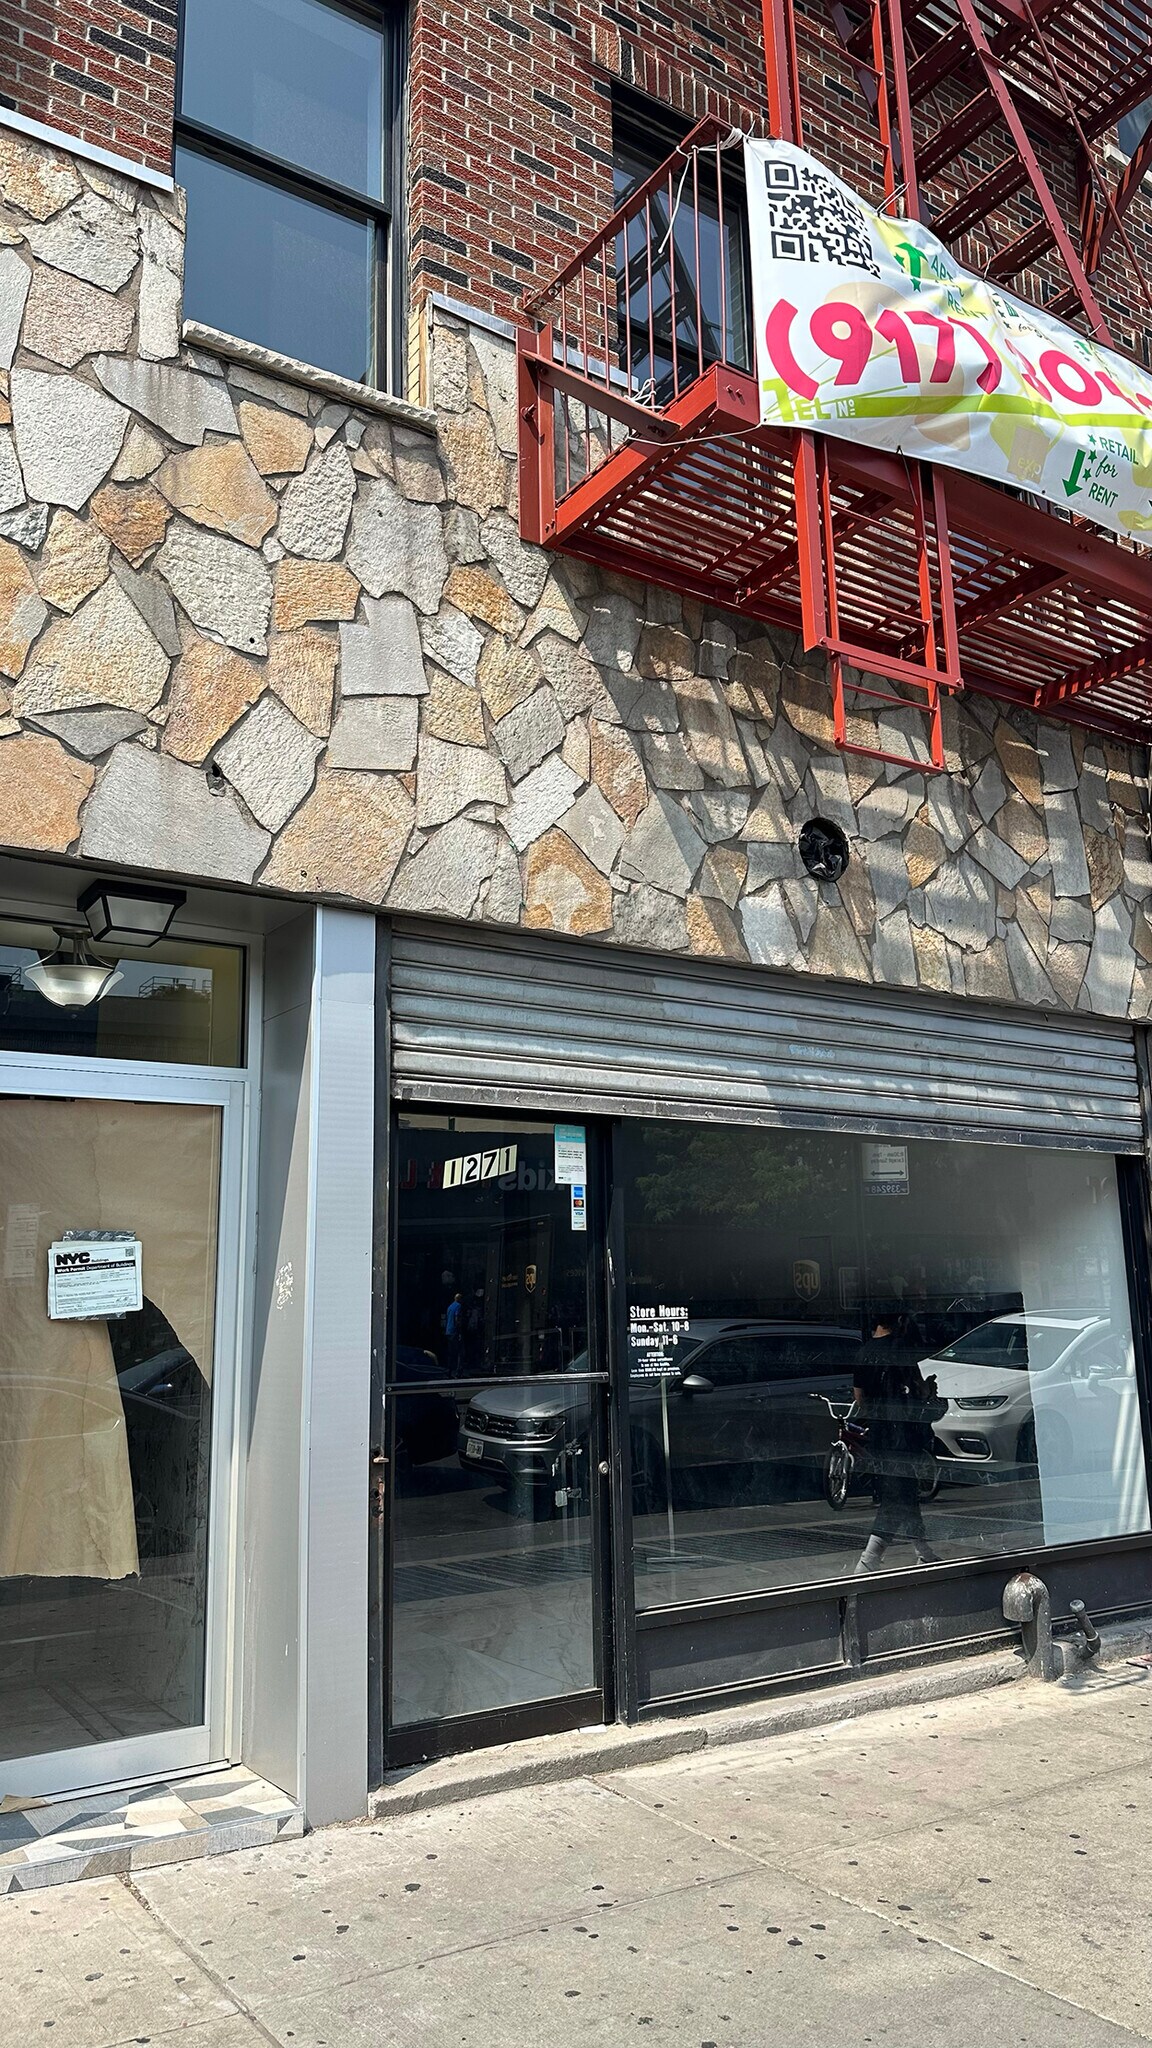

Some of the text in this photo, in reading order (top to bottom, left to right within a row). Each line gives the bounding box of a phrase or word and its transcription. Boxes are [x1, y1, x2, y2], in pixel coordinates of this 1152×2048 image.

[946, 290, 989, 321] RENT
[765, 298, 1002, 401] (917)
[1098, 436, 1139, 466] RETAIL
[1095, 454, 1120, 478] for
[1088, 482, 1119, 508] RENT
[450, 1147, 511, 1186] 1271
[56, 1252, 91, 1266] NYC
[86, 1264, 110, 1272] Department
[630, 1305, 689, 1318] Store Hours:
[630, 1321, 690, 1333] Mon.-Sat. 10-8
[661, 1334, 679, 1346] 11-6
